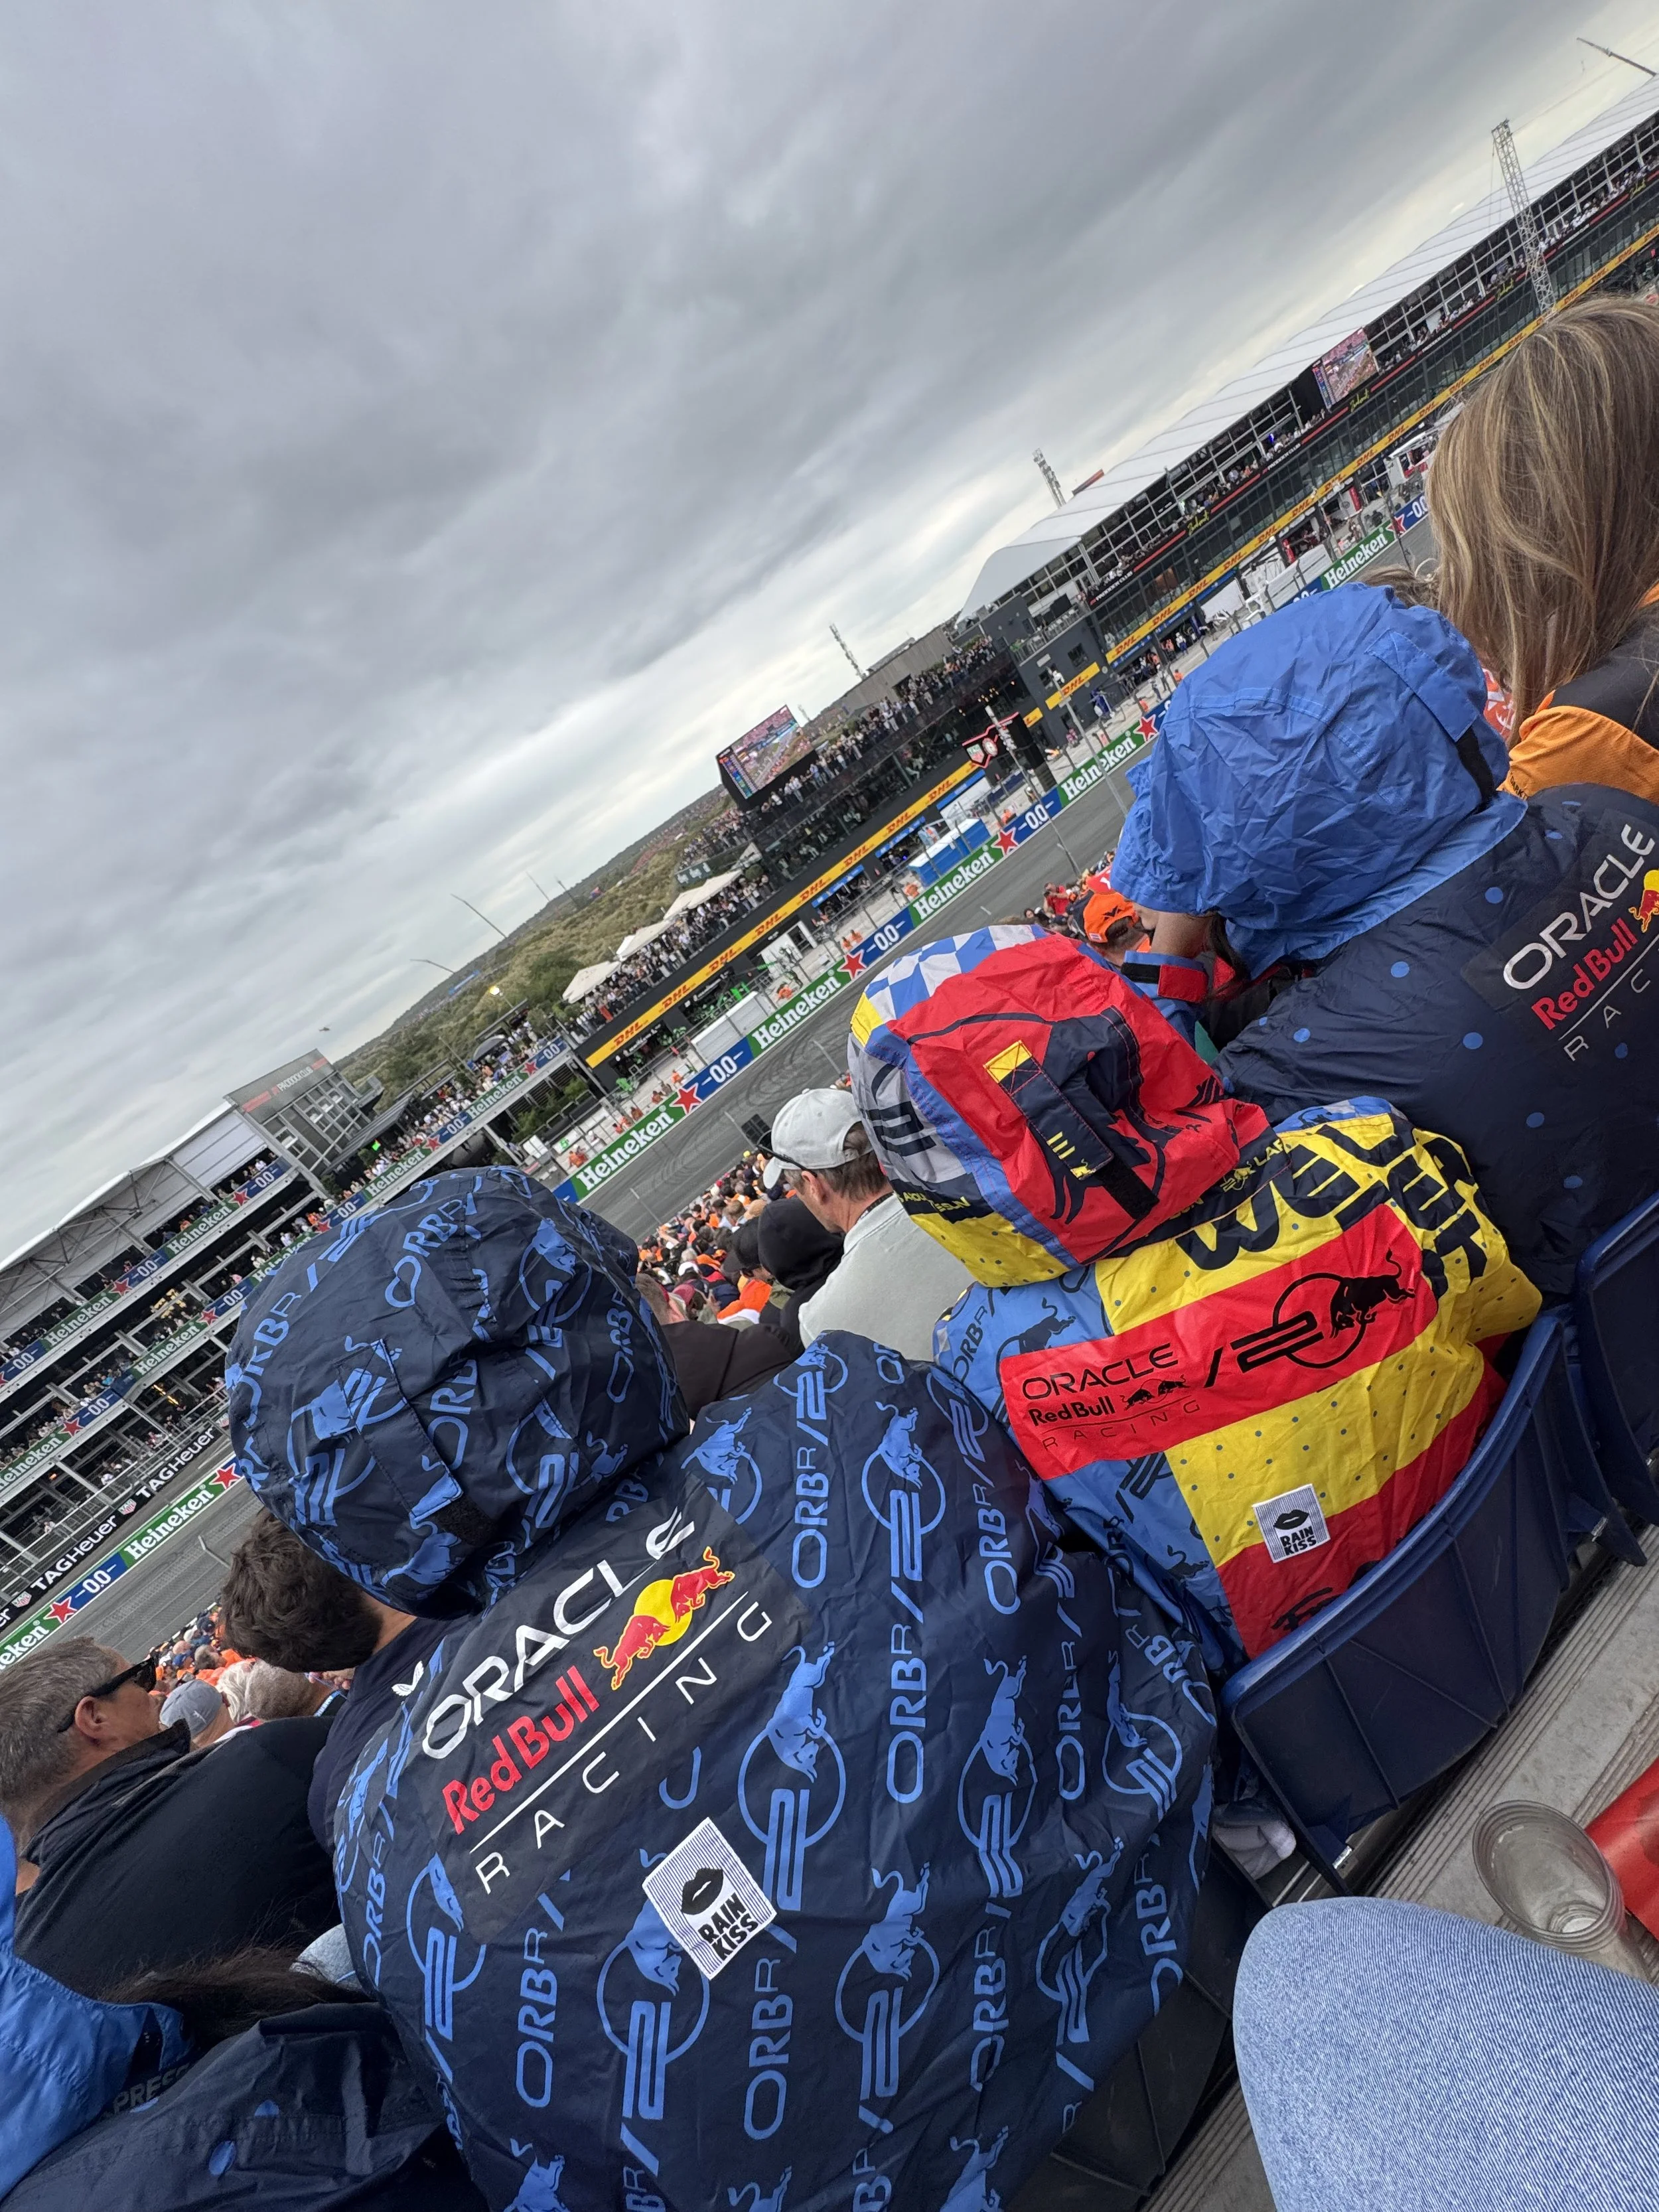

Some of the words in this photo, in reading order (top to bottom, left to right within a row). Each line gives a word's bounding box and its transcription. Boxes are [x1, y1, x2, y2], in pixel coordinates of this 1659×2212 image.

[1388, 425, 1406, 441] DHL
[1356, 450, 1374, 467] DHL
[1291, 500, 1311, 517] DHL
[1258, 525, 1277, 542] DHL
[1223, 552, 1244, 569] DHL
[1188, 579, 1208, 597] DHL
[1152, 607, 1173, 626] DHL
[1115, 634, 1137, 654] DHL
[1062, 677, 1085, 696] DHL
[928, 780, 953, 800] DHL
[886, 810, 910, 834] DHL
[843, 846, 869, 867] DHL
[800, 879, 827, 901] DHL
[1502, 823, 1655, 990] ORACLE
[755, 913, 782, 936] DHL
[709, 948, 737, 973] DHL
[662, 984, 691, 1008] DHL
[613, 1021, 643, 1046] DHL
[1022, 1342, 1179, 1400] ORACLE
[1042, 1399, 1200, 1451] RACING
[1279, 1525, 1314, 1548] RAIN
[1283, 1535, 1317, 1556] KISS
[422, 1505, 695, 1759] ORACLE
[474, 1601, 772, 1895] RACING
[697, 1892, 747, 1944] RAIN
[711, 1913, 758, 1961] KISS
